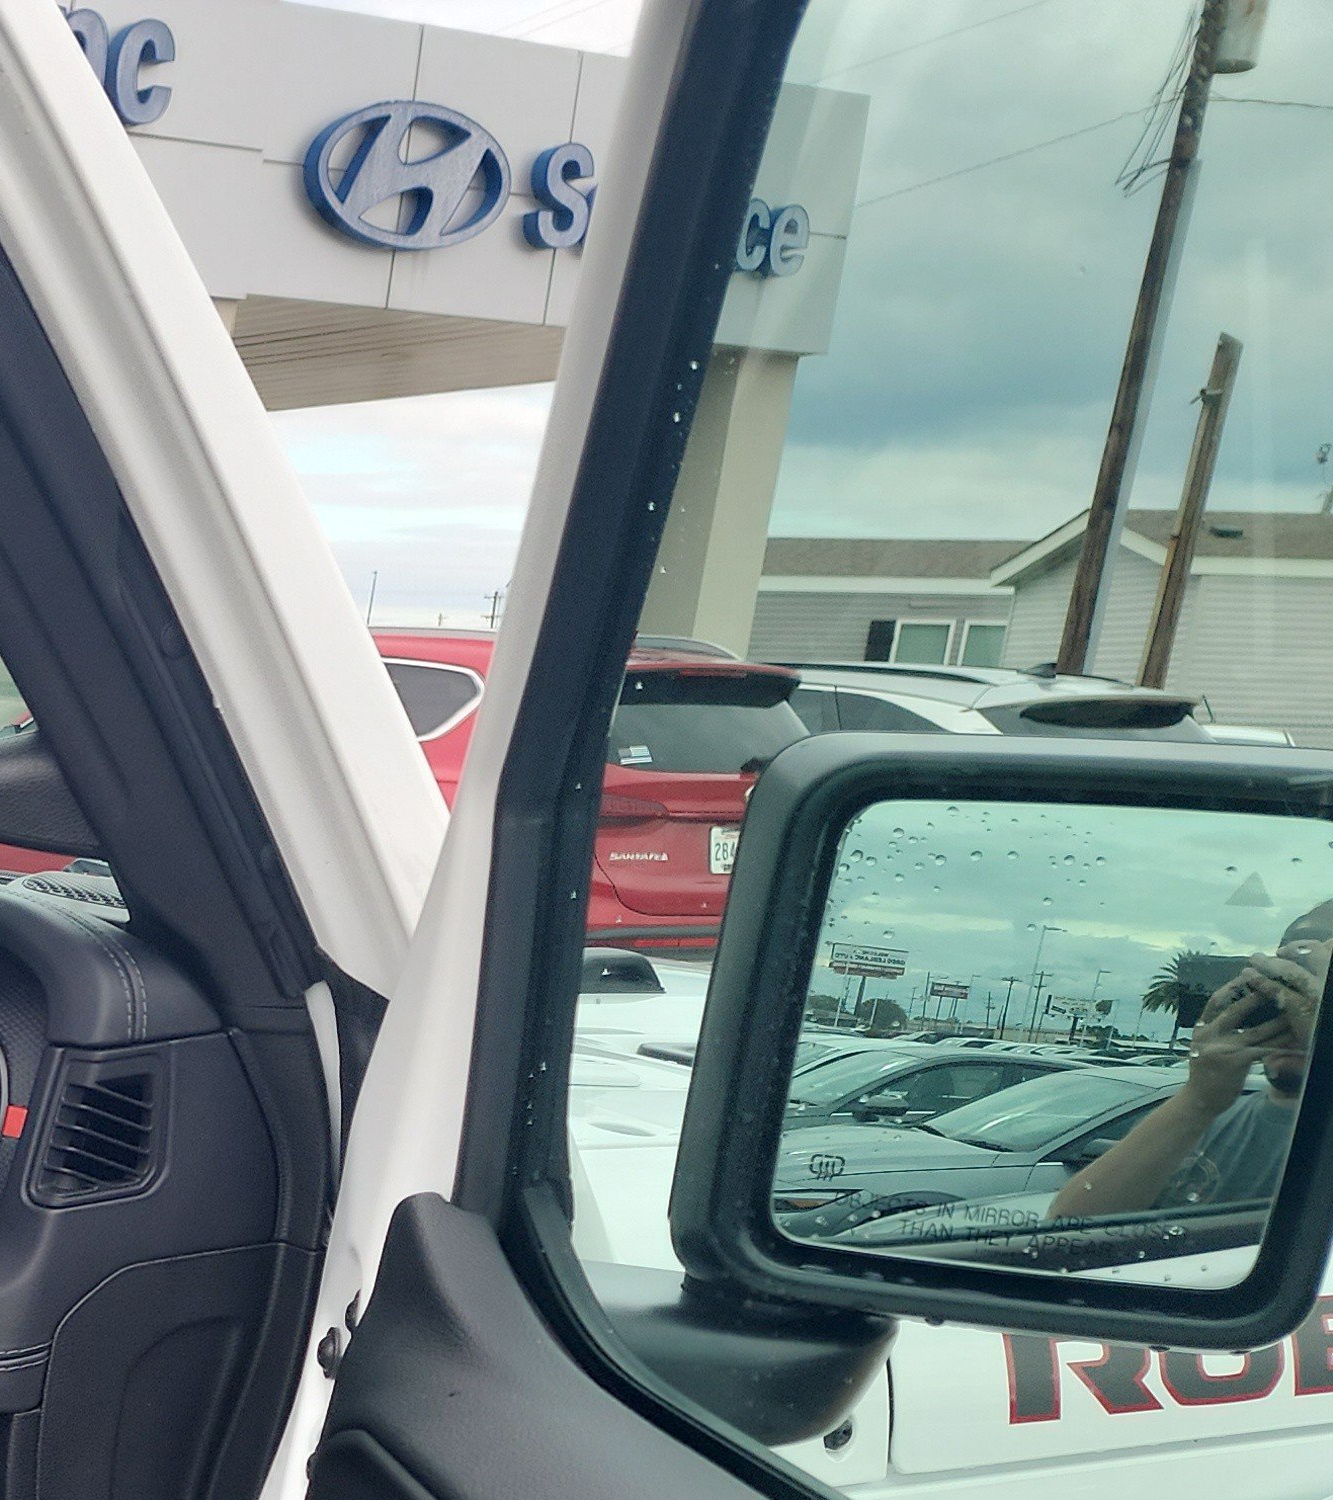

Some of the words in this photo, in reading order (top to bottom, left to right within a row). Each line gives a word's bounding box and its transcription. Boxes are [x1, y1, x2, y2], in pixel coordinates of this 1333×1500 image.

[933, 1204, 955, 1219] IN
[964, 1205, 1040, 1230] MIRROR
[898, 1219, 954, 1242] THAN
[965, 1226, 1013, 1248] THEY
